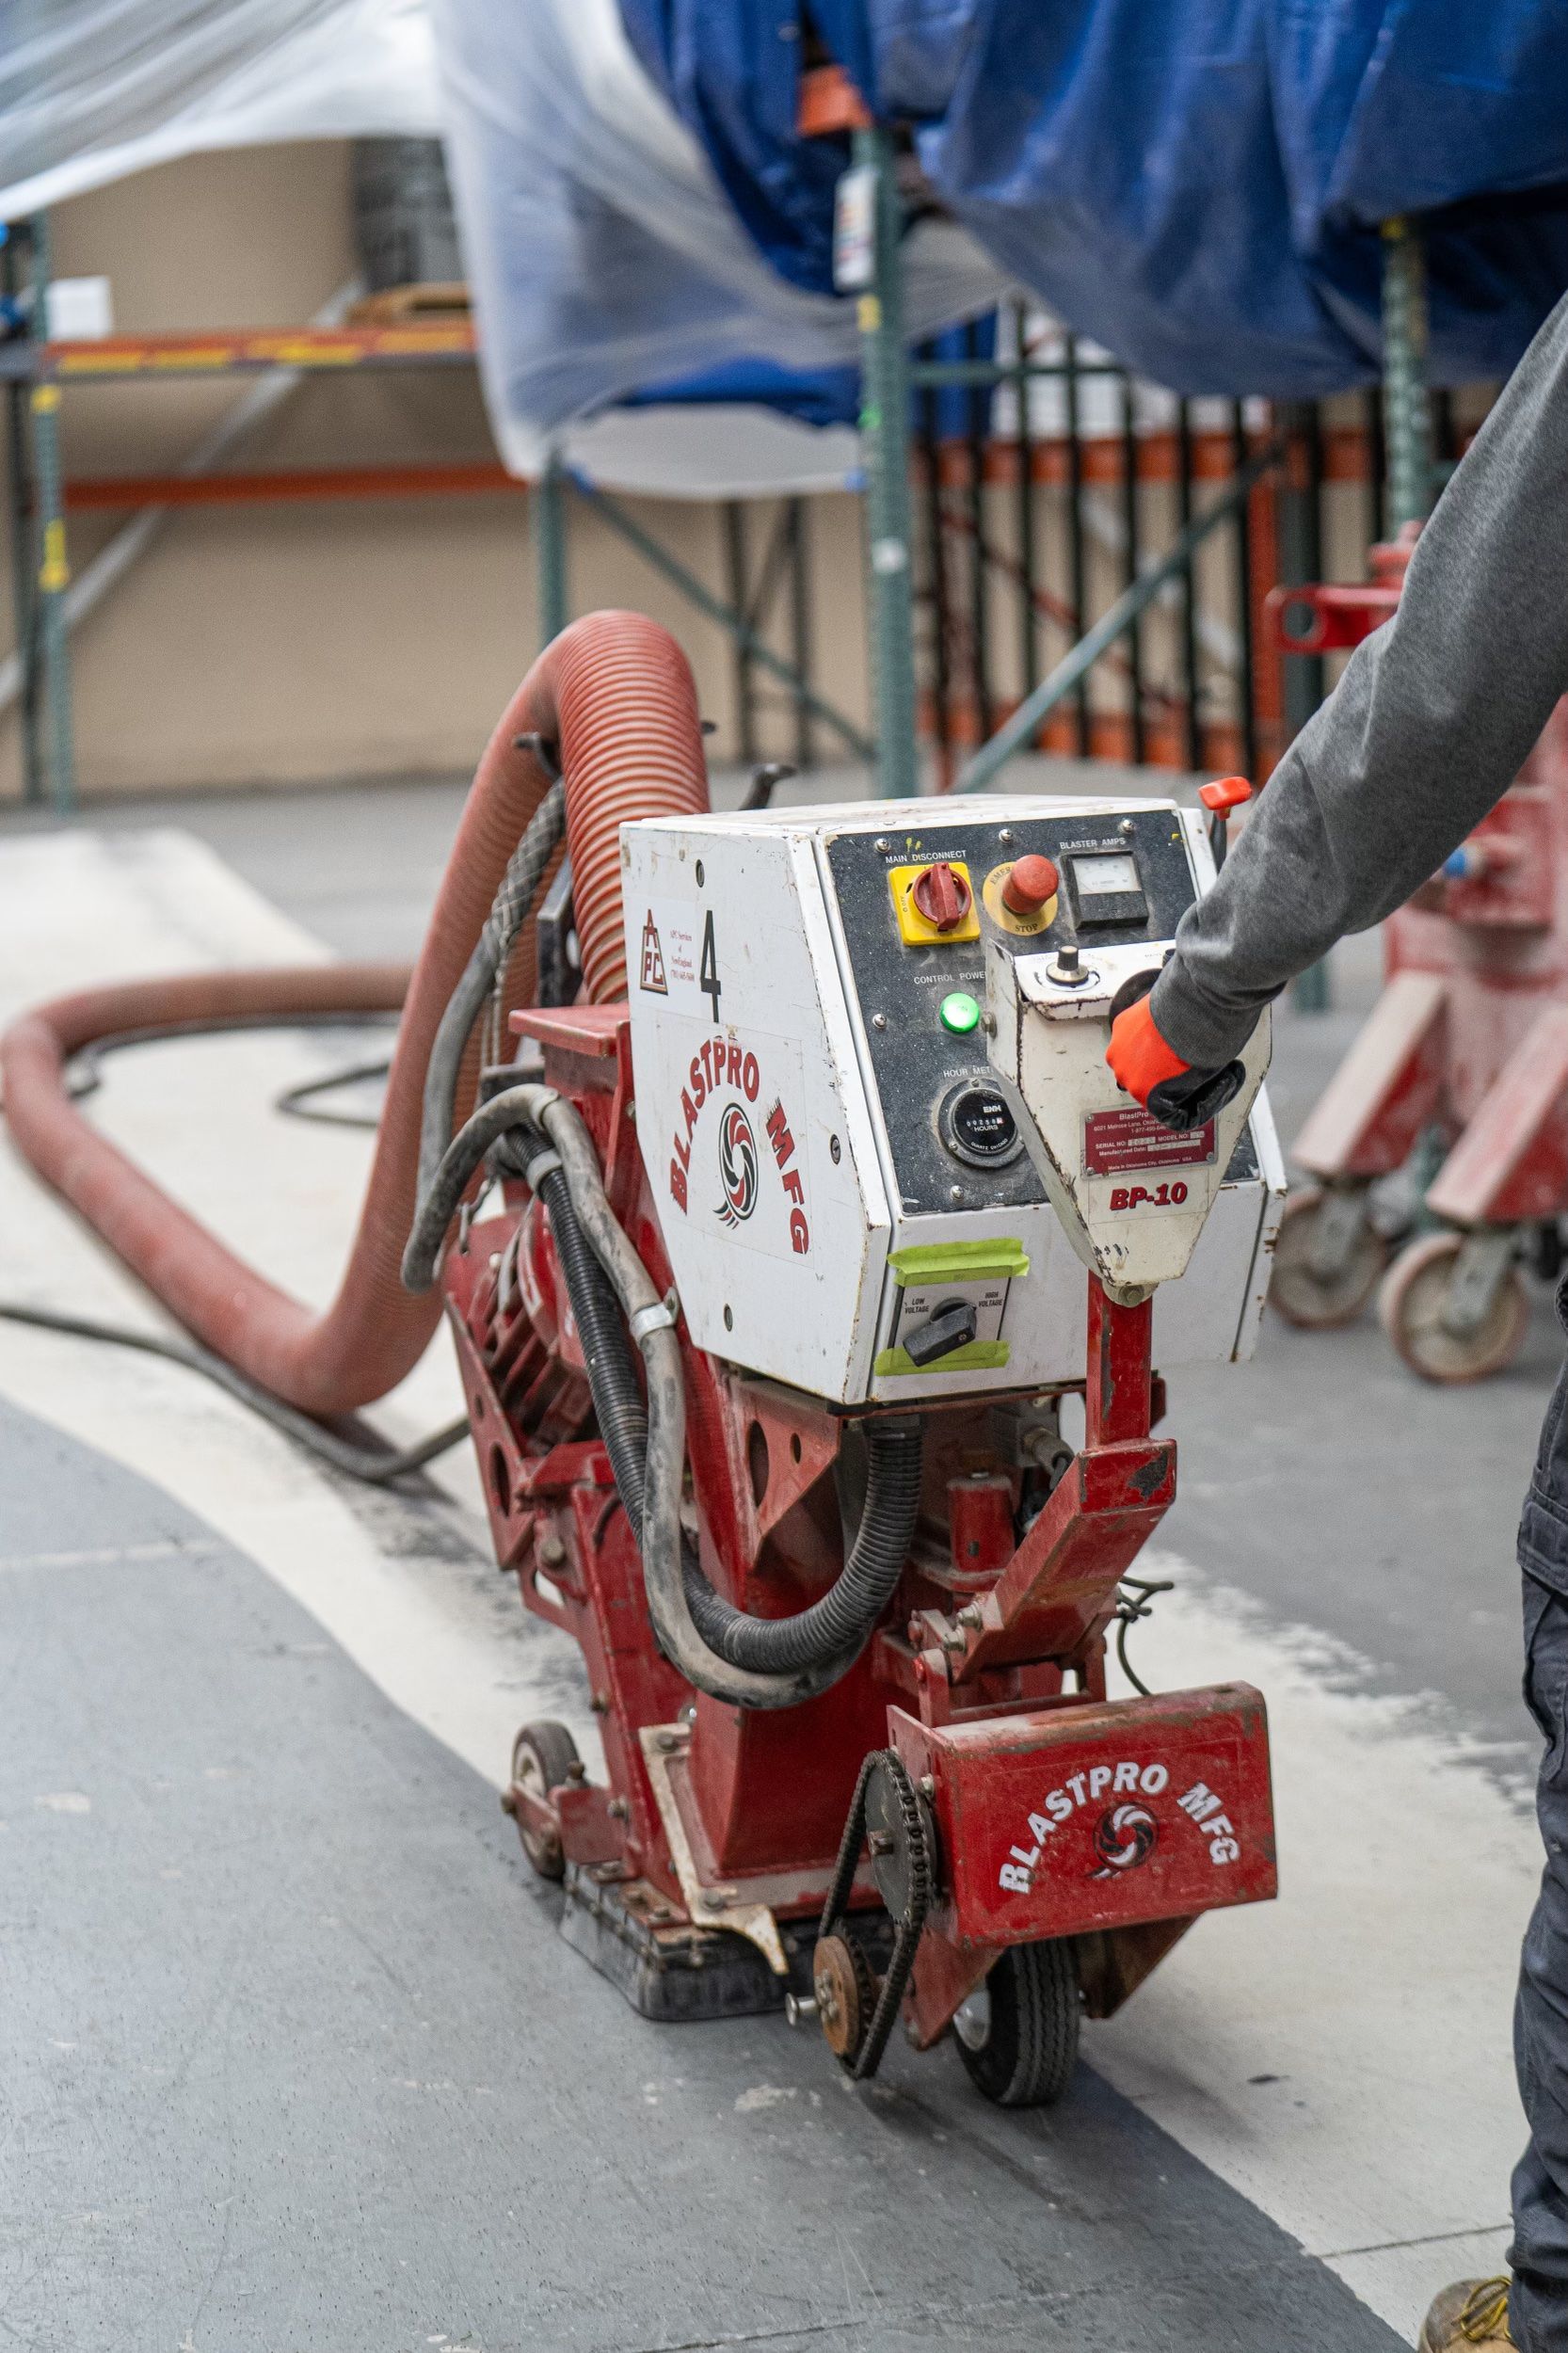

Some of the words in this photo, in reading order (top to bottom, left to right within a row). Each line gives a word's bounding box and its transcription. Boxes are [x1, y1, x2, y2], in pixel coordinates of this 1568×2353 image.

[1060, 840, 1097, 850] BLASTER
[1102, 837, 1126, 846] AMPS
[885, 855, 908, 864] MAIN
[912, 850, 967, 862] DISCONNECT
[1016, 924, 1038, 933] STOP
[699, 910, 722, 1023] 4
[914, 975, 955, 984] CONTROL
[959, 971, 986, 981] POWE
[943, 1069, 968, 1078] HOUR
[973, 1065, 994, 1075] MET
[1119, 1112, 1149, 1121] BlastPro
[670, 1035, 760, 1216] BLASTPRO
[973, 1124, 999, 1132] HOURS
[1158, 1134, 1178, 1143] MODEL
[1099, 1148, 1133, 1157] Manufactured
[766, 1096, 809, 1255] MFG
[1110, 1182, 1188, 1211] BP-10
[904, 1305, 929, 1314] VOLTAGE
[978, 1299, 1002, 1307] VOLTAGE
[999, 1761, 1169, 1895] BLASTPRO
[1176, 1782, 1240, 1865] MFG
